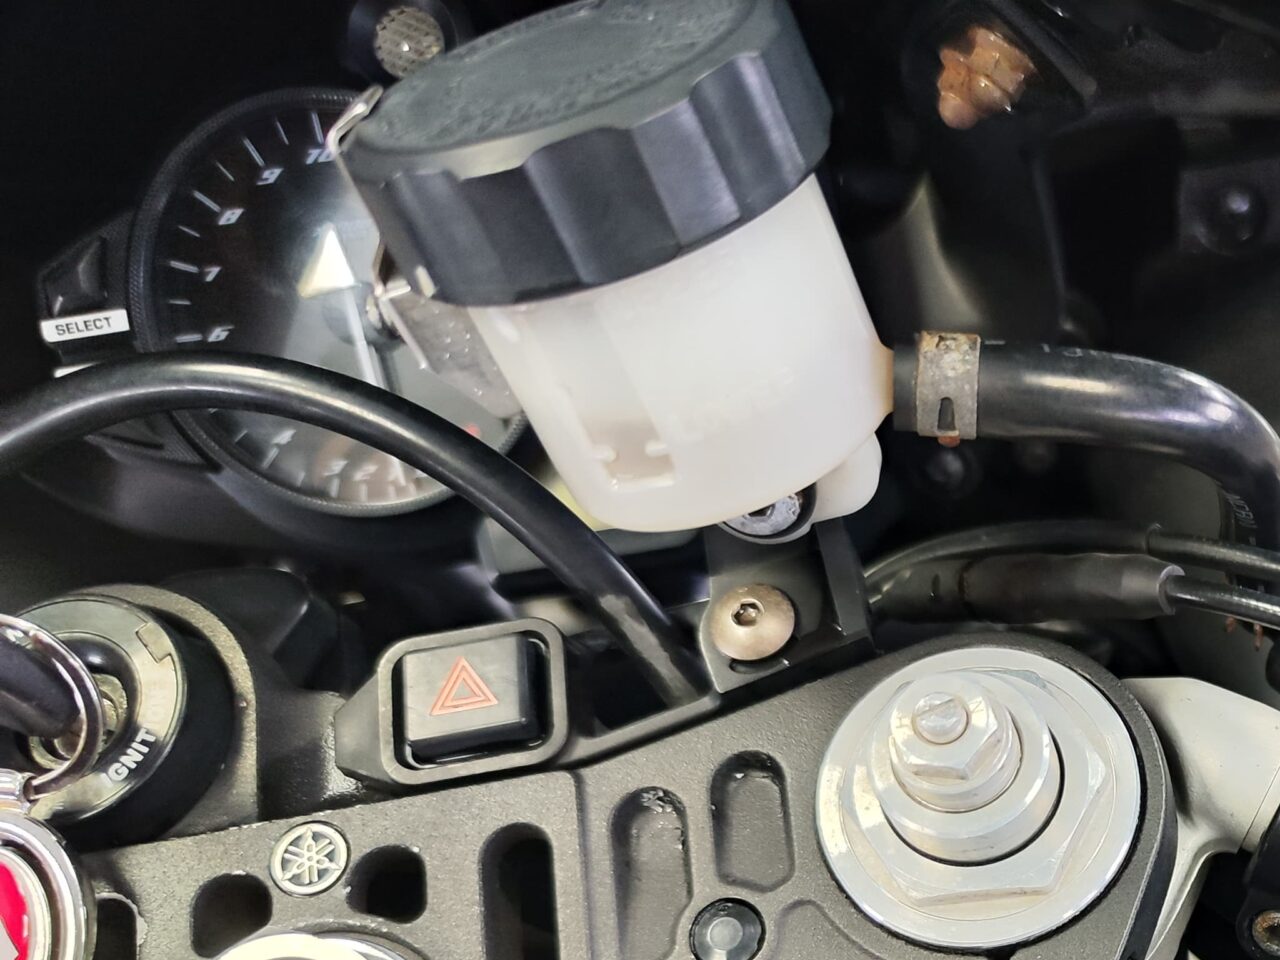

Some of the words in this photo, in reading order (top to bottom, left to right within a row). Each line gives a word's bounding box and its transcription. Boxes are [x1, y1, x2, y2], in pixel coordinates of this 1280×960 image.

[255, 167, 285, 185] 9
[217, 208, 245, 225] 8
[204, 266, 222, 282] 7
[55, 316, 113, 335] SELECT
[207, 325, 235, 342] 6
